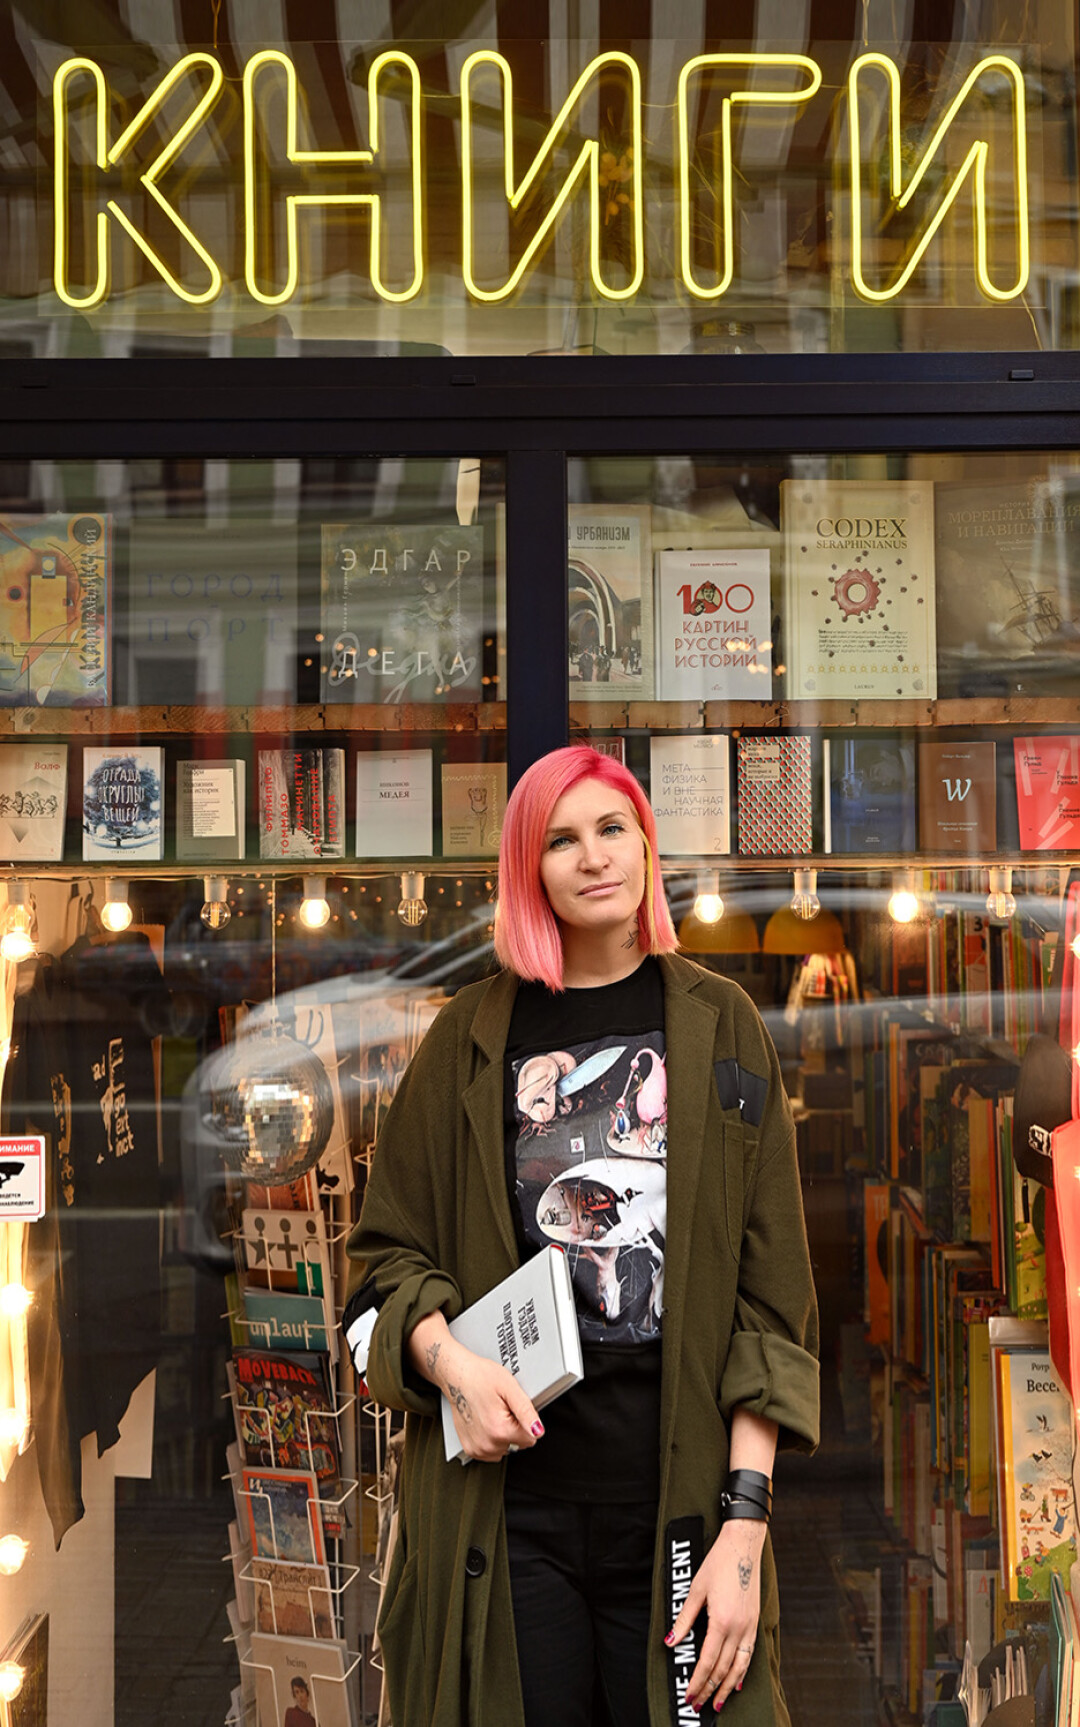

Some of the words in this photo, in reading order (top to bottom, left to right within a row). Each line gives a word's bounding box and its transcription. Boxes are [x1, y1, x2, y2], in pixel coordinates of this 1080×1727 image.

[53, 50, 1030, 307] КНИГИ
[576, 526, 630, 541] УРБАНИЗМ
[816, 517, 908, 538] CODEX
[816, 540, 908, 549] SERAPHINIANUS
[340, 548, 472, 574] ЭДГАР
[146, 573, 284, 601] ГОРОД
[676, 581, 755, 616] 100
[147, 617, 284, 642] ПОРТ
[682, 620, 749, 634] КАРТИН
[674, 635, 758, 651] РУССКОЙ
[338, 651, 468, 679] ДЕГА
[674, 653, 758, 669] ИСТОРИИ
[102, 767, 142, 783] ОТРАДА
[661, 775, 708, 784] ФИЗИКА
[662, 764, 691, 773] МЕТА
[264, 766, 273, 832] ФИЛИППО
[294, 753, 305, 831] МАРИНЕТТИ
[379, 791, 410, 799] МЕДЕЯ
[662, 787, 671, 795] И
[674, 787, 696, 795] ВНЕ
[674, 796, 723, 805] НАУЧНАЯ
[104, 803, 140, 822] ВЕЩЕЙ
[310, 768, 322, 856] ОЧАРОВАНИЕ
[328, 794, 338, 842] ЕГИПТА
[653, 807, 723, 818] ФАНТАСТИКА
[280, 793, 290, 856] ТОММАЗО
[714, 837, 722, 852] 2
[517, 1305, 532, 1350] ГЭДДИС
[526, 1297, 540, 1345] УИЛЬЯМ
[496, 1322, 510, 1366] ГОТИКА
[503, 1301, 520, 1376] ПЛОТНИЦКАЯ
